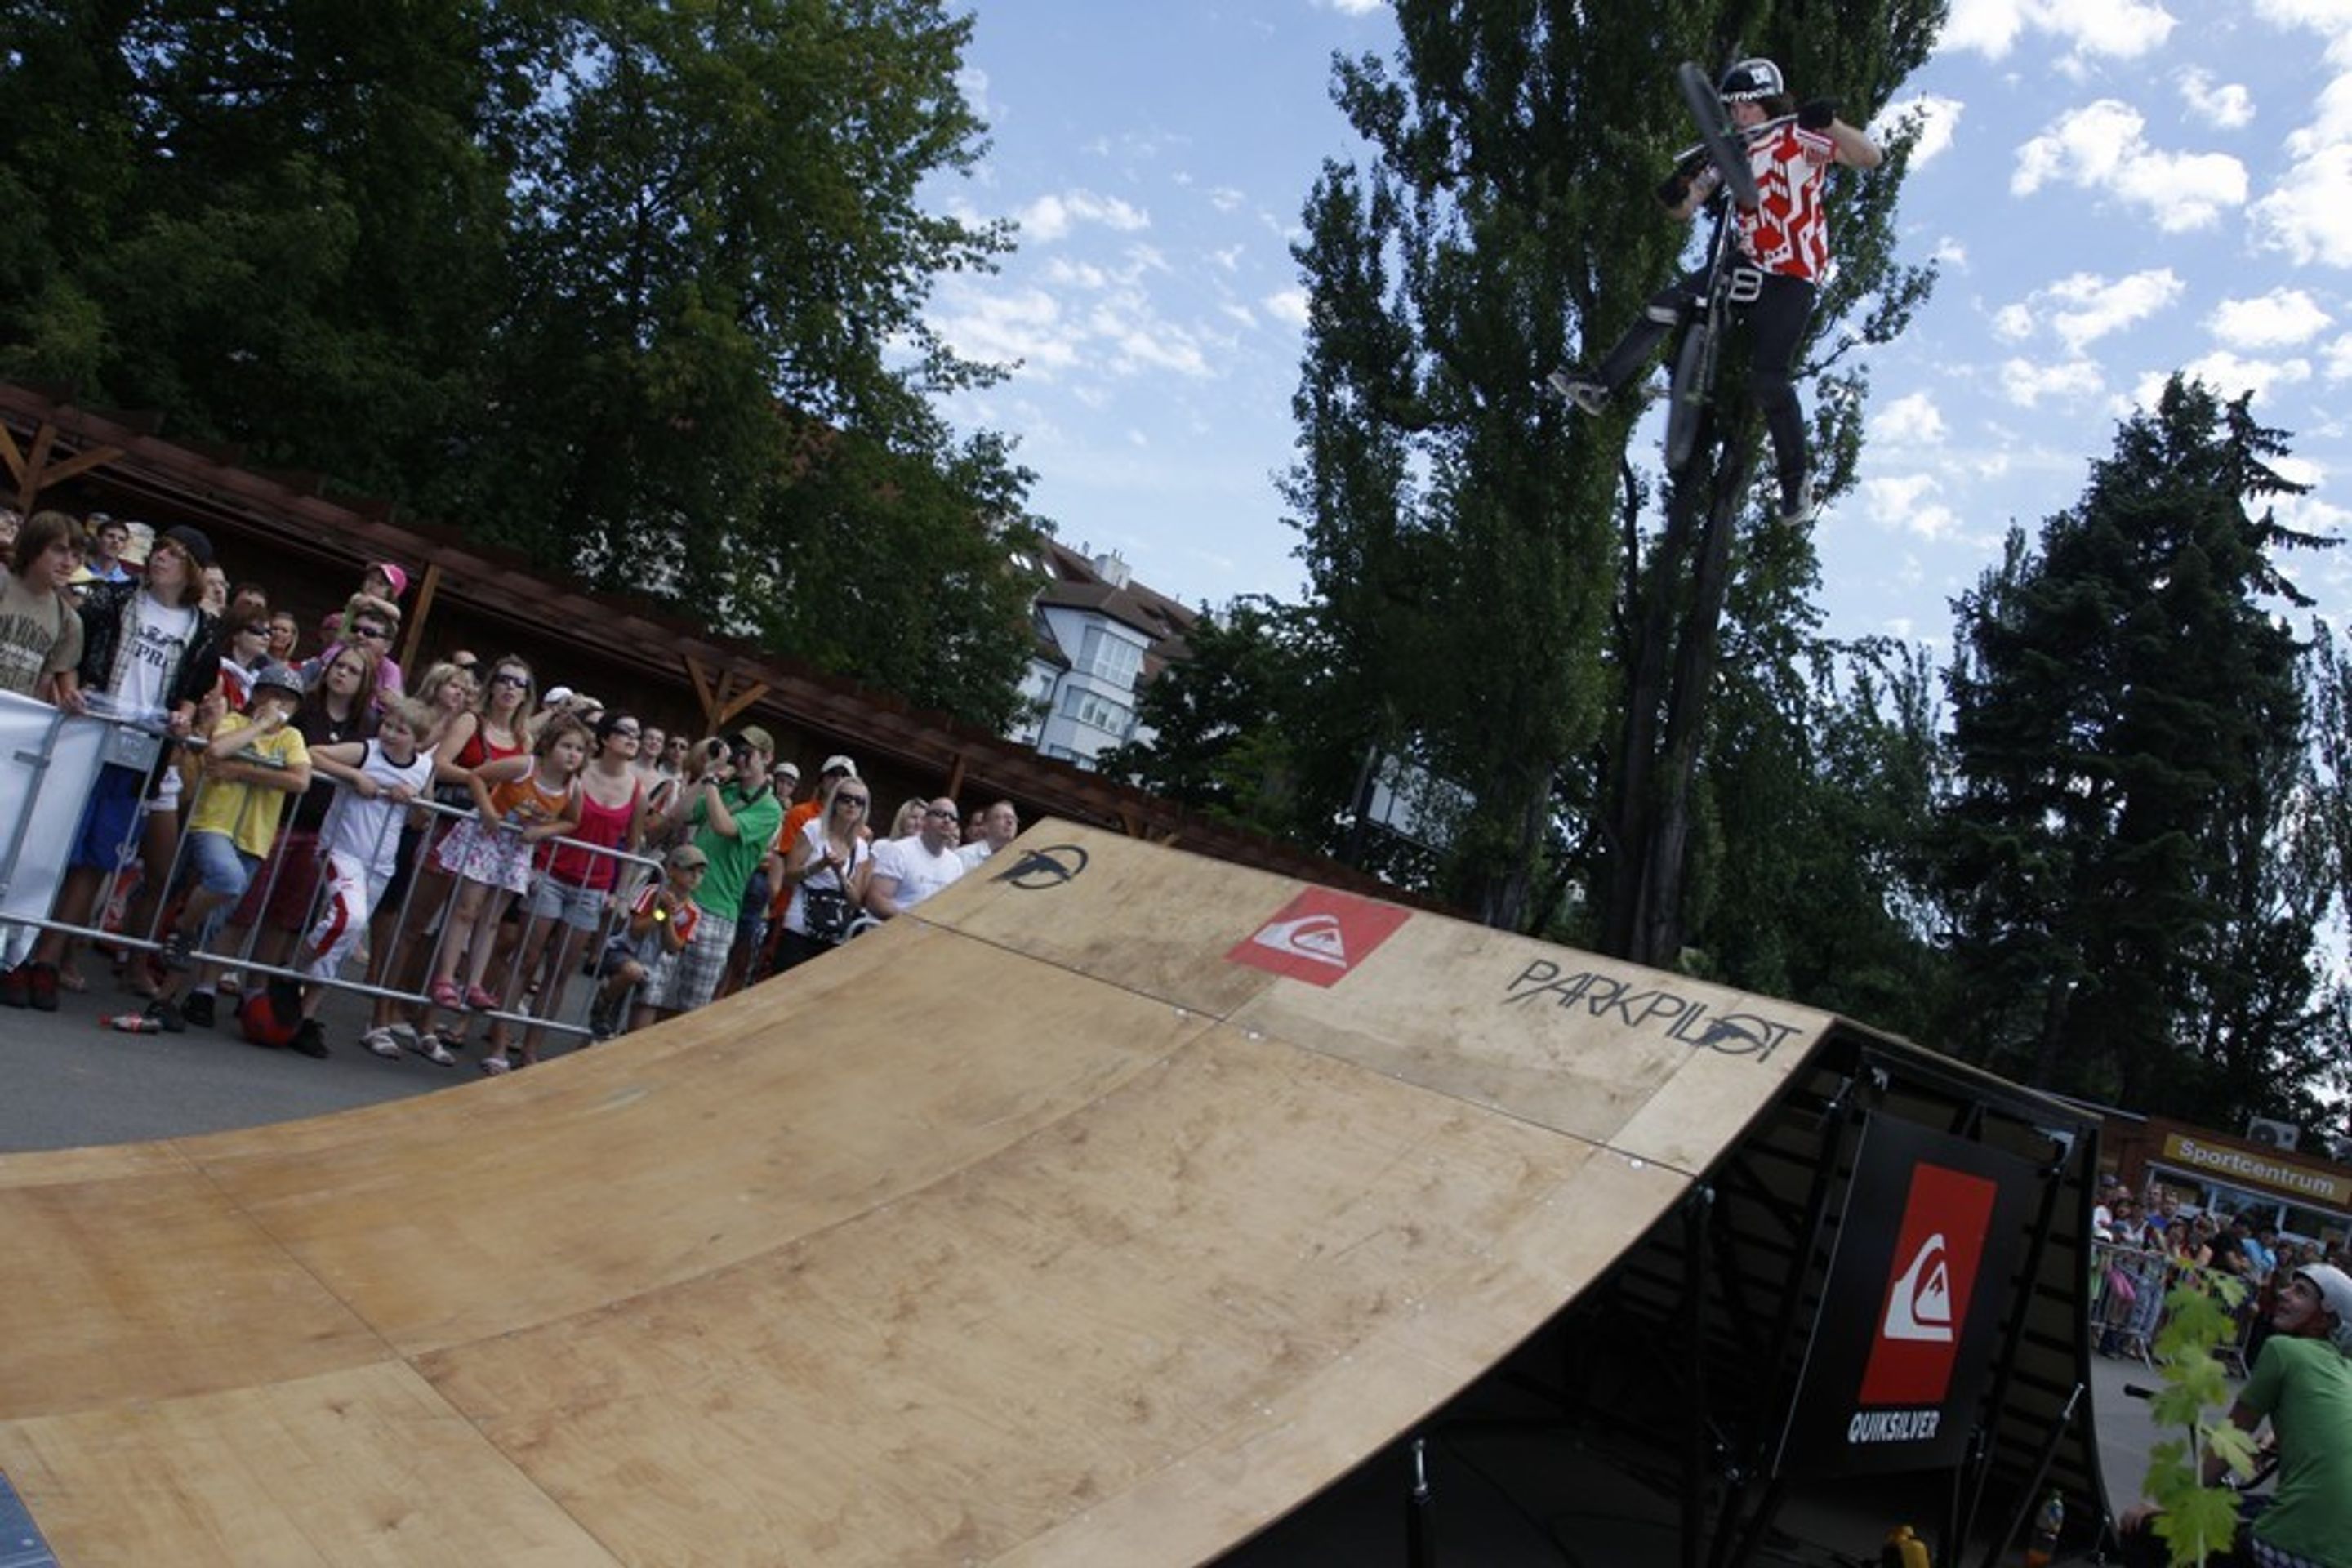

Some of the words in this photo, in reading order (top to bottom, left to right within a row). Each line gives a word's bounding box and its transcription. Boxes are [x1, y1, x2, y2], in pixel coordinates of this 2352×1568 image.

[1504, 959, 1802, 1064] PARKPILOT
[2179, 1138, 2335, 1196] Sportcentrum
[1847, 1410, 1940, 1443] QUIKSILVER
